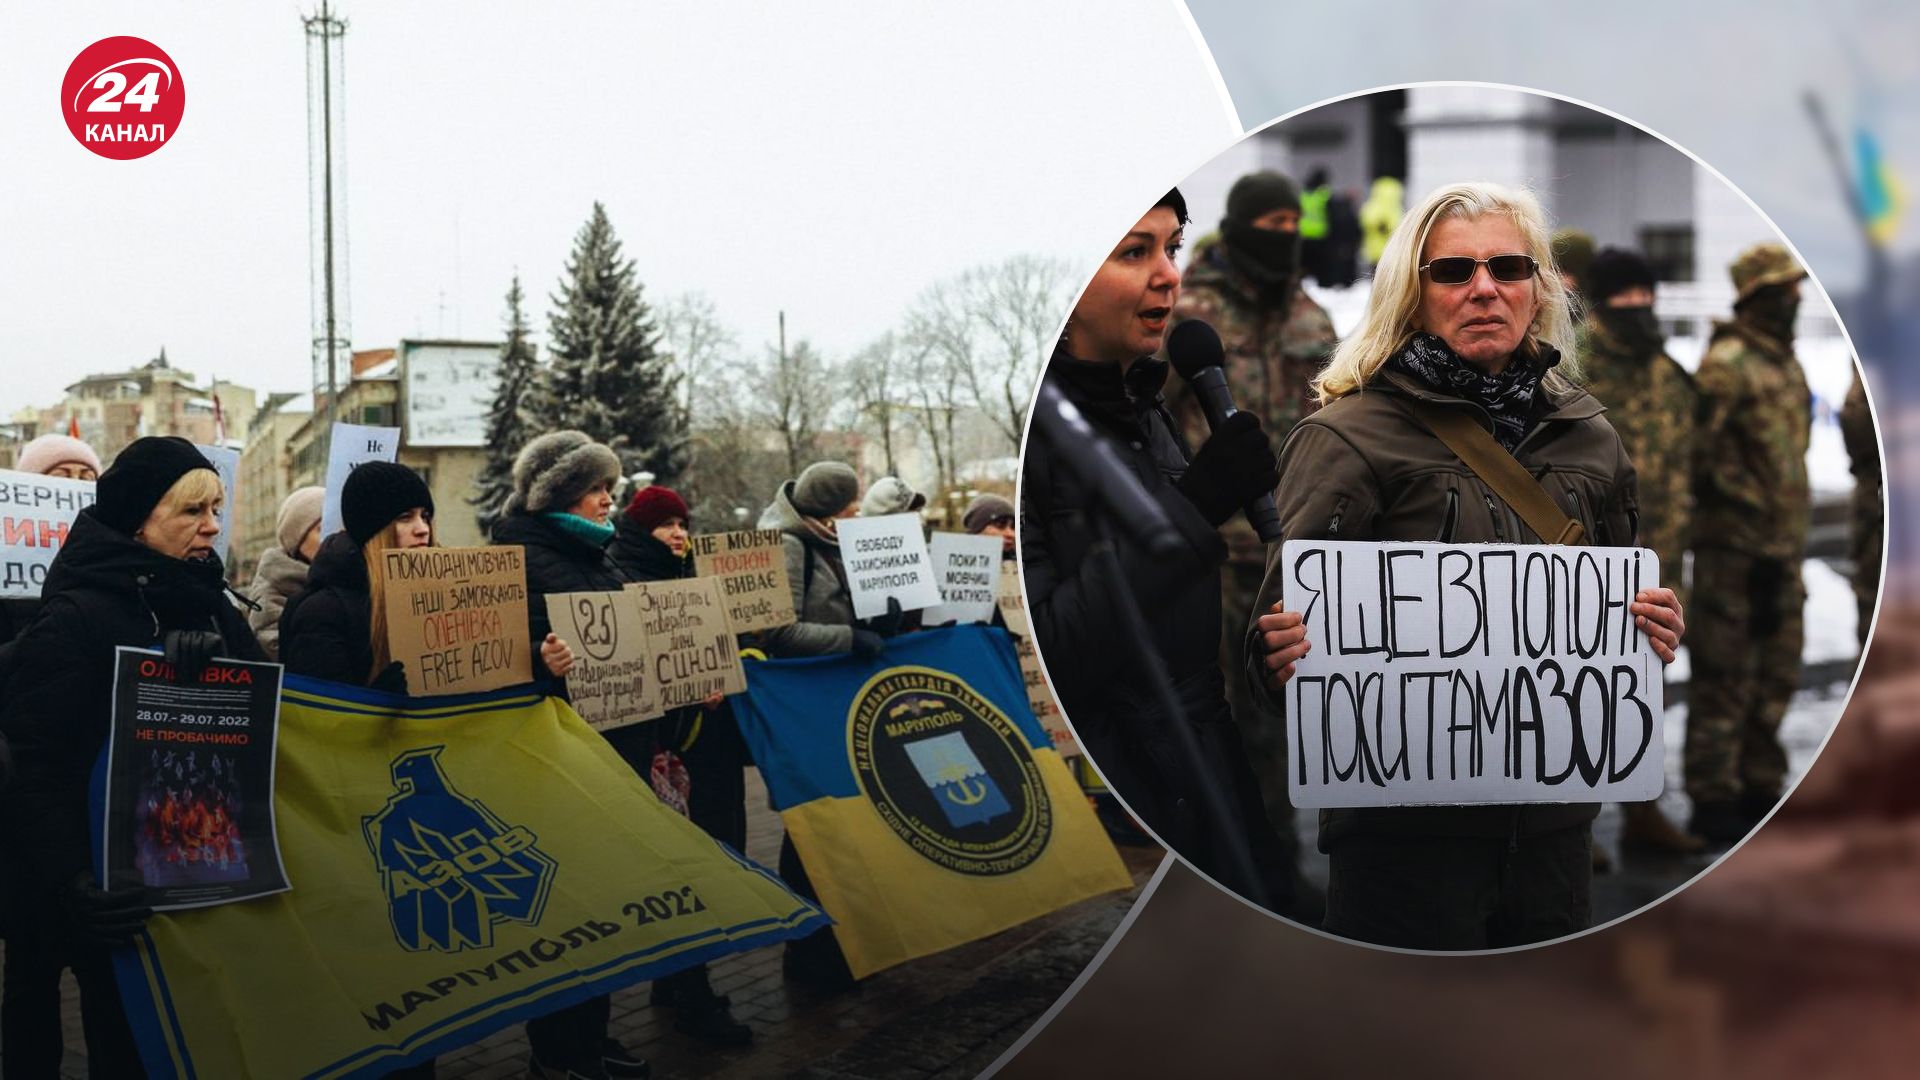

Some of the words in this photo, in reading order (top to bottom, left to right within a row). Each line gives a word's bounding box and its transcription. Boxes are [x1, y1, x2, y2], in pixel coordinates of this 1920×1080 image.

[367, 440, 384, 453] Не
[694, 535, 718, 556] НЕ
[727, 528, 783, 550] МОВЧИ
[854, 535, 904, 552] СВОБОДУ
[711, 550, 771, 575] ПОЛОН
[850, 553, 920, 573] ЗАХИСНИКАМ
[949, 553, 978, 568] ПОКИ
[978, 555, 990, 568] ТИ
[721, 570, 777, 596] БИВАЄ
[858, 571, 920, 592] МАРІУПОЛЯ
[946, 571, 991, 586] МОВЧИШ
[411, 590, 445, 616] ІНШІ
[950, 589, 992, 602] КАТУЮТЬ
[579, 599, 611, 645] 25
[729, 597, 772, 624] rigade
[423, 609, 502, 650] ОЛЕНІВКА
[139, 660, 253, 685] ОЛВКА
[420, 647, 464, 691] FREE
[471, 638, 514, 677] AZOV
[218, 715, 250, 726] 2022
[885, 709, 964, 738] МАРІУПОЛЬ
[136, 729, 155, 741] НЕ
[157, 730, 249, 745] ПРОБАЧИМО
[360, 919, 622, 1032] МАРІУПОЛЬ
